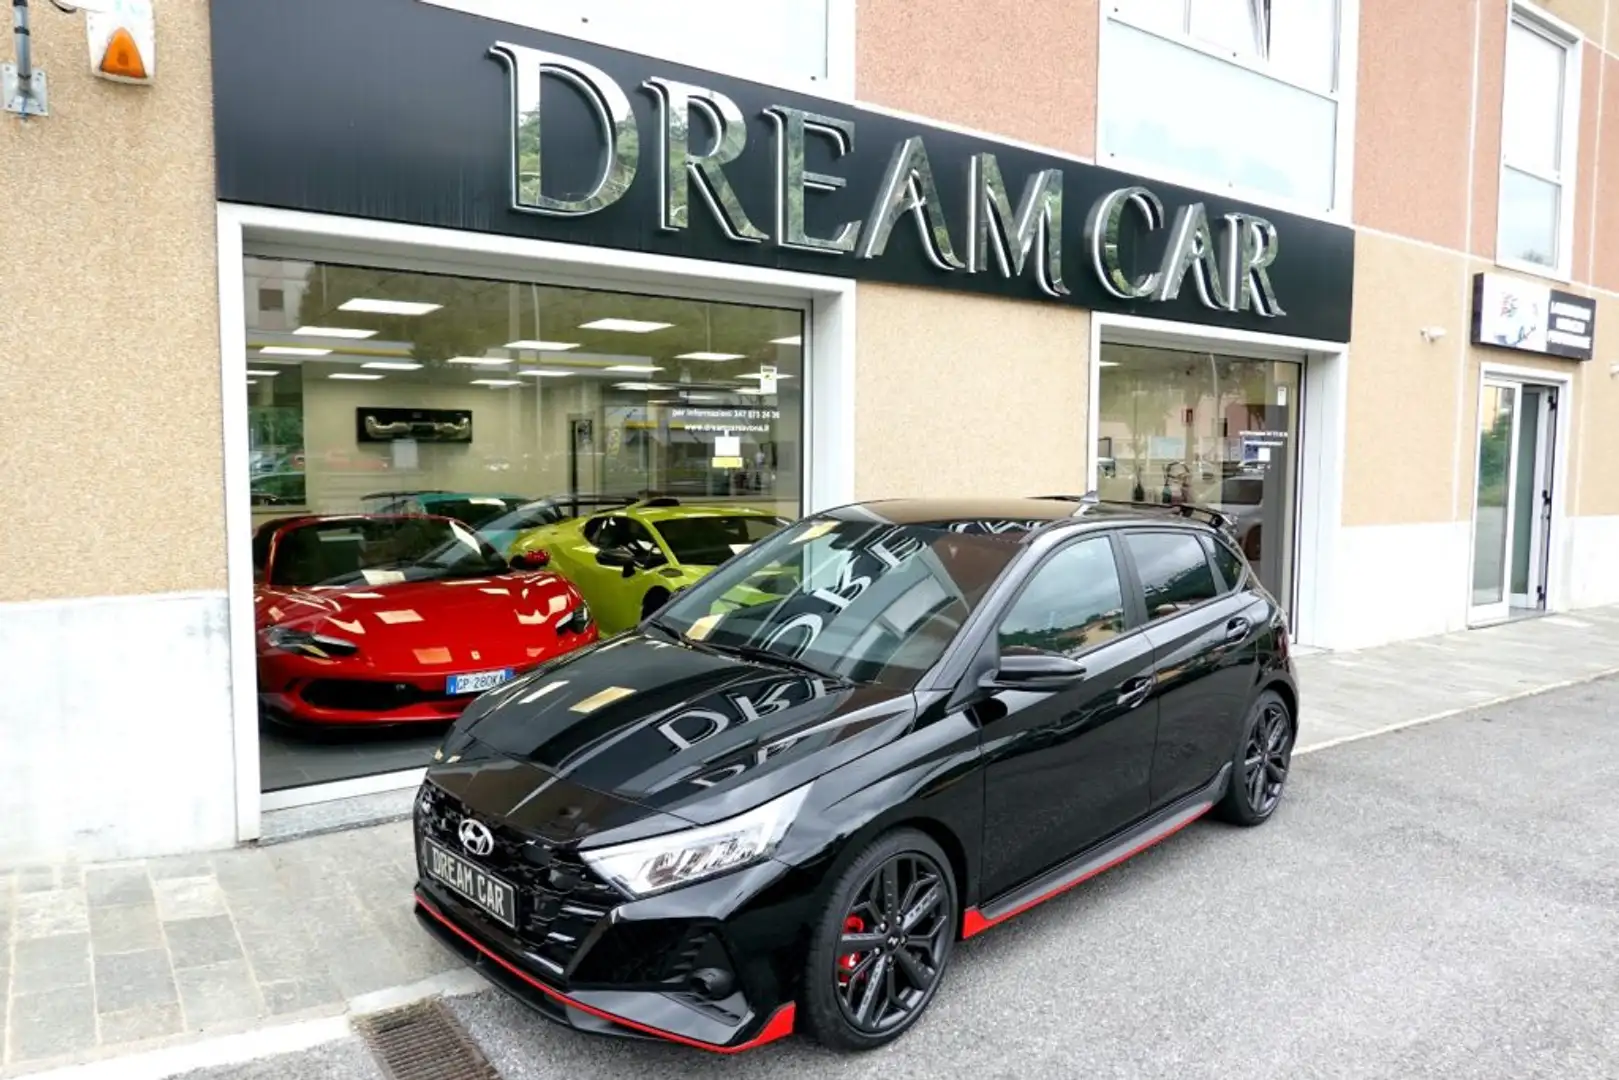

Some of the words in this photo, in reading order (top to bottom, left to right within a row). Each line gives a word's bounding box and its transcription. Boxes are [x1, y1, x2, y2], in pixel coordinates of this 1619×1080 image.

[486, 41, 1071, 297] DREAM
[1083, 186, 1287, 317] CAR
[672, 408, 685, 418] per
[431, 846, 474, 896] DREAM
[477, 874, 505, 916] CAR
